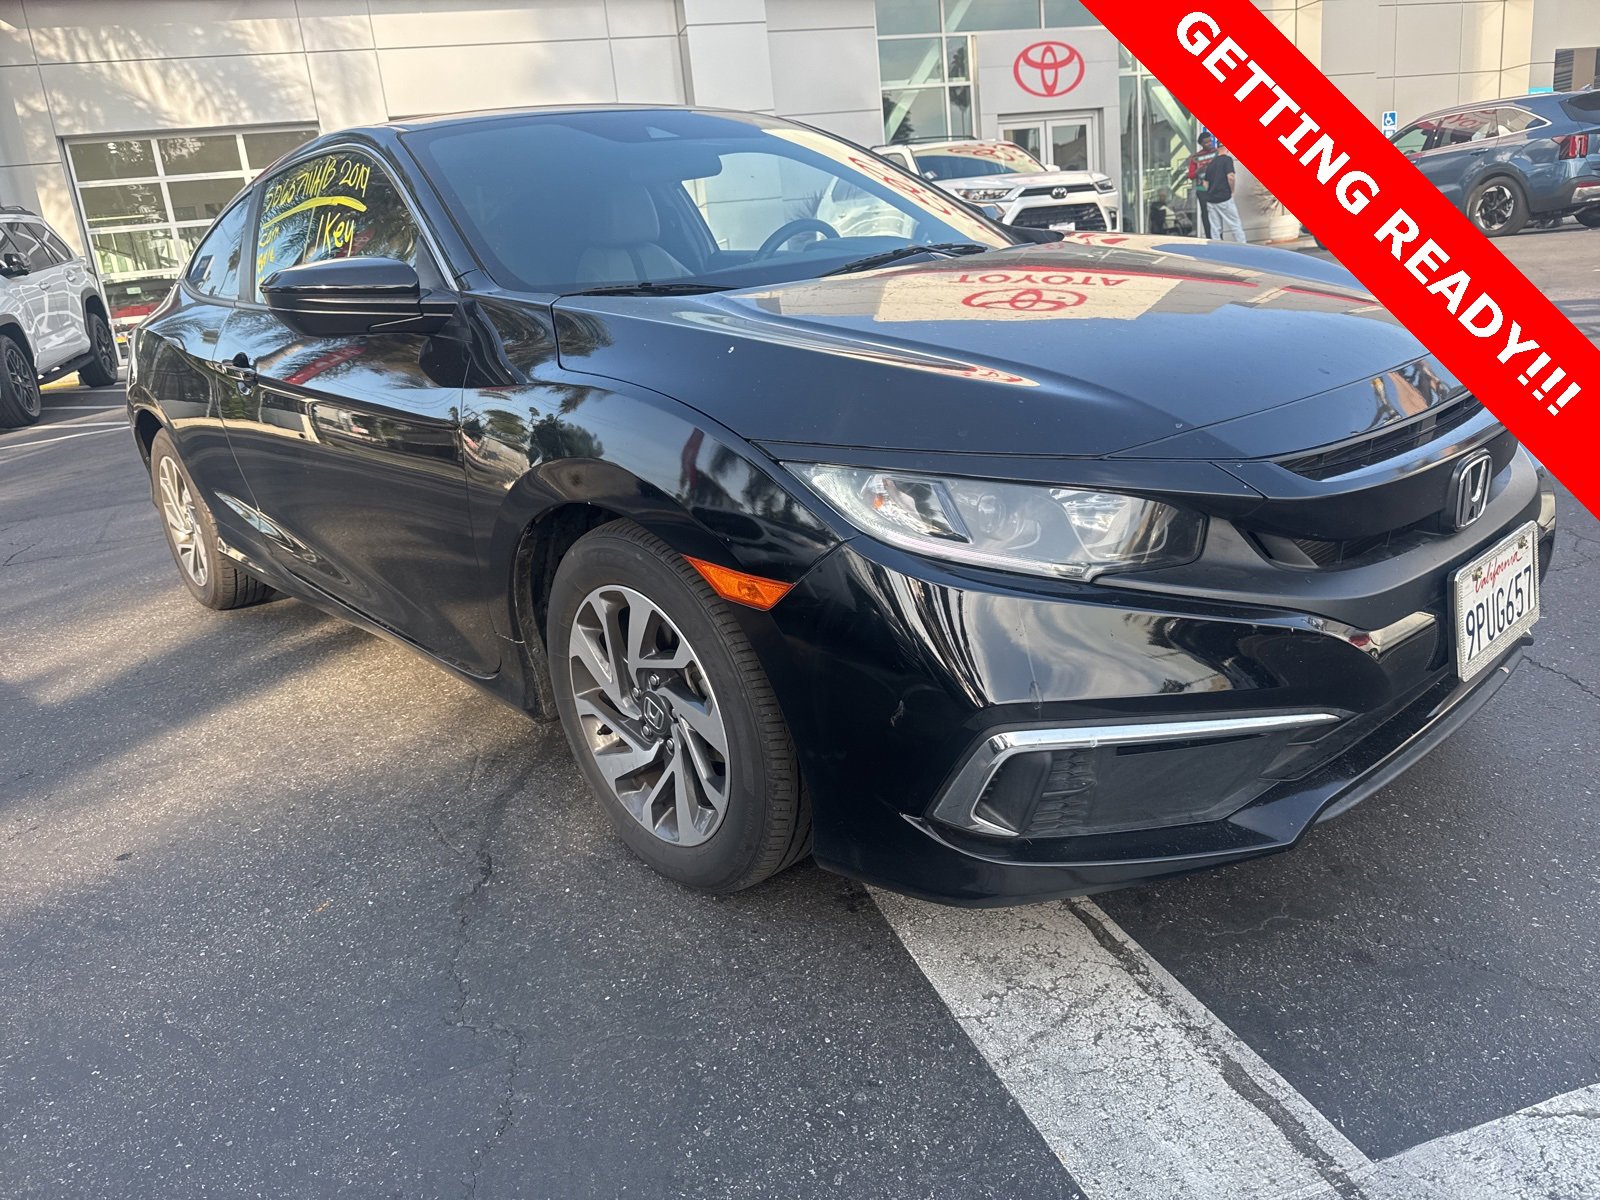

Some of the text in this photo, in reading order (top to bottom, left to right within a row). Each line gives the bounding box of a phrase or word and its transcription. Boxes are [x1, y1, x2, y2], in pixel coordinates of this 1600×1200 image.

[339, 160, 370, 198] 2019
[322, 212, 354, 258] Key
[1475, 550, 1522, 593] California
[1466, 564, 1532, 660] 9PUG657
